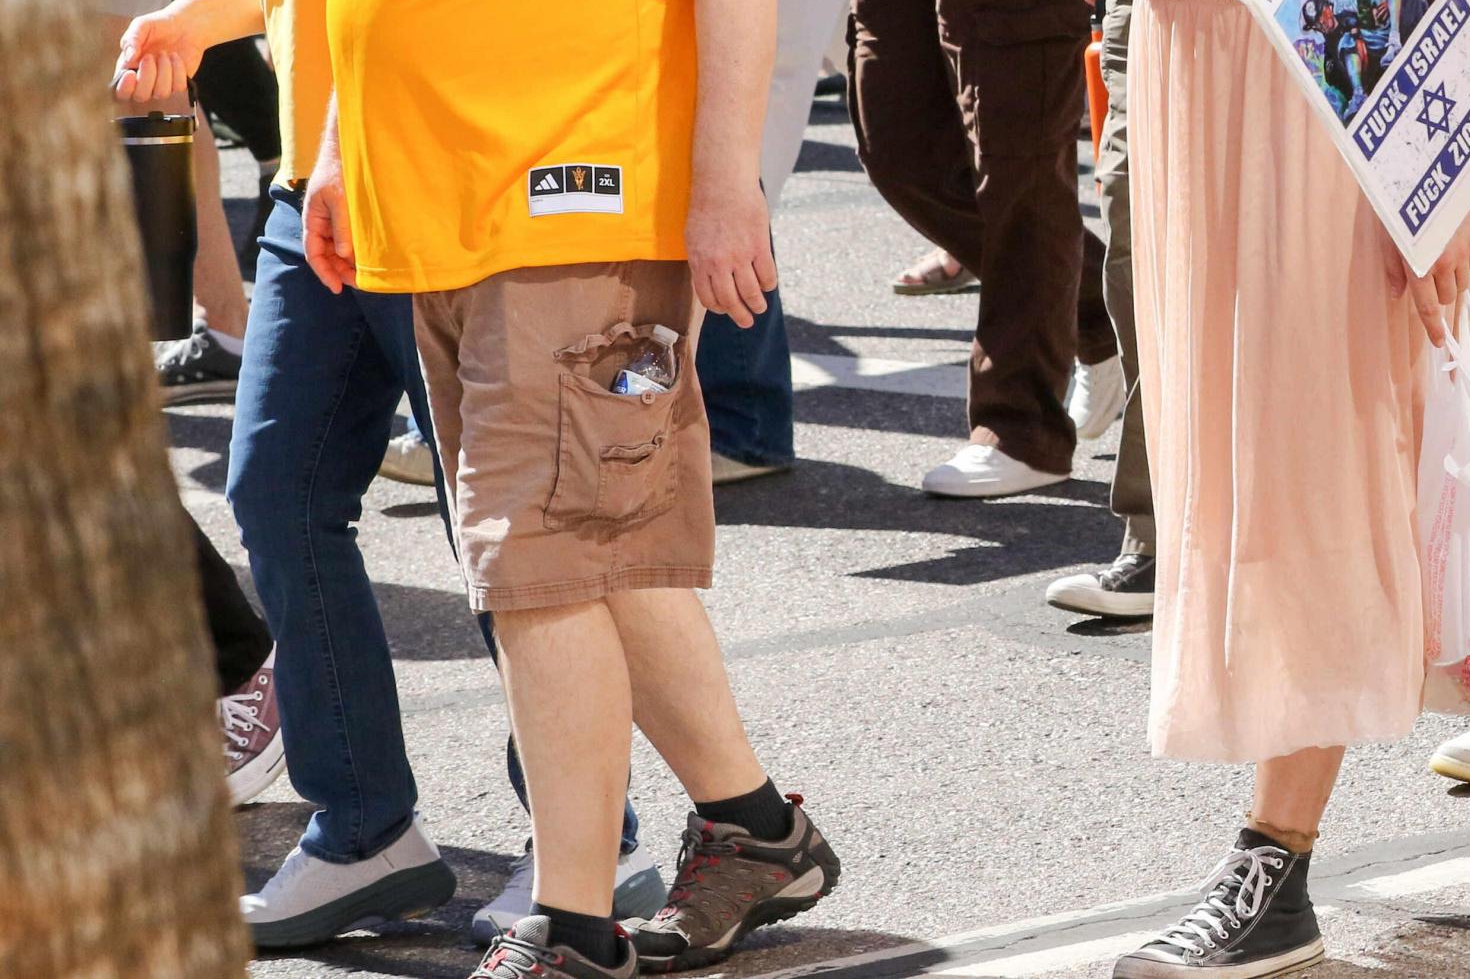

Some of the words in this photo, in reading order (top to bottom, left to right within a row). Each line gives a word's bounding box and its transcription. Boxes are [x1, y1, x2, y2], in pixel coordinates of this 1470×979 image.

[1357, 80, 1409, 153] FUCK
[1403, 0, 1468, 87] ISRAEL
[598, 177, 616, 187] 2XL
[1404, 163, 1453, 229] FUCK
